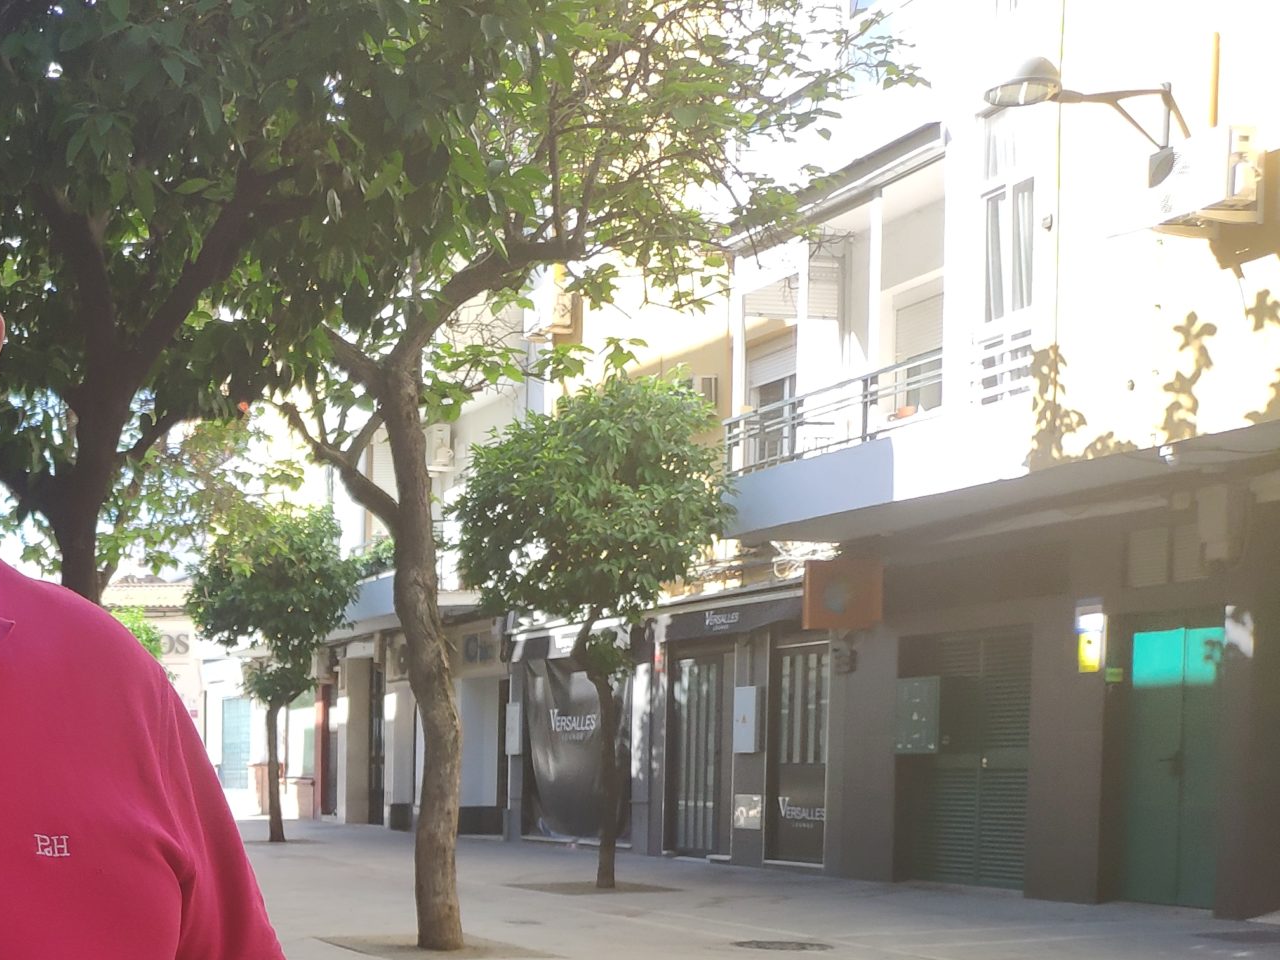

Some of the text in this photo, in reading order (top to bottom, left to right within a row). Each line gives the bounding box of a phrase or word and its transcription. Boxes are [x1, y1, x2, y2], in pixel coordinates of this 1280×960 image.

[705, 611, 739, 626] VERSALLES
[549, 709, 597, 732] VERSALLES
[778, 796, 826, 820] VERSALLES
